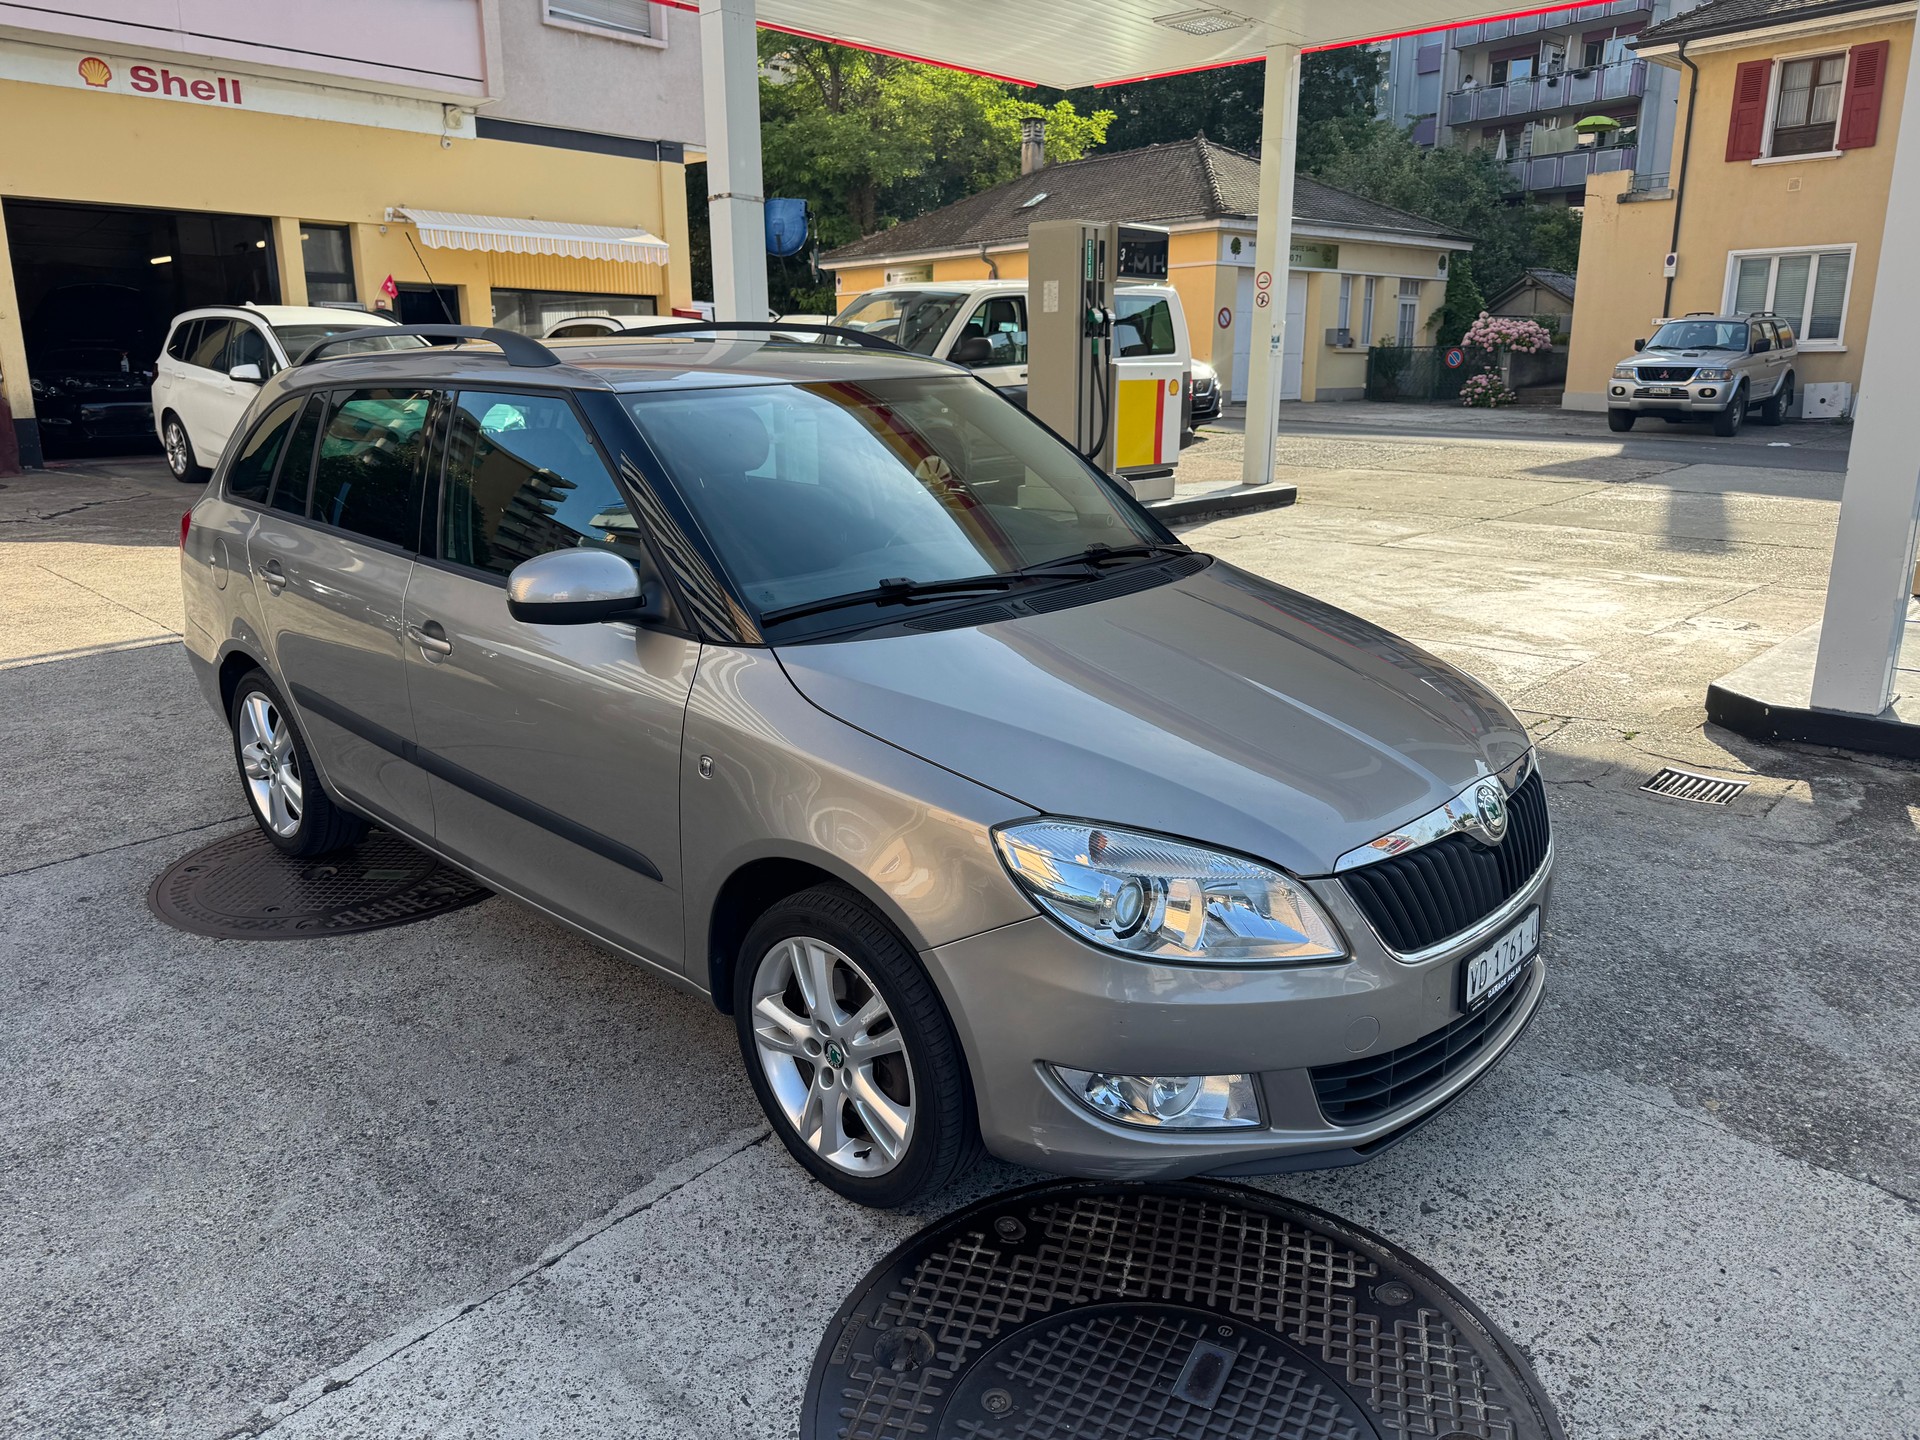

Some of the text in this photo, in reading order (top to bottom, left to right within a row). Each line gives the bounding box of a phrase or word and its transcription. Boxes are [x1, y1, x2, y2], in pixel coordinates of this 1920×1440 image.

[130, 66, 242, 104] Shell
[1120, 248, 1127, 261] 3
[1487, 964, 1522, 998] GARAGE ASLAN
